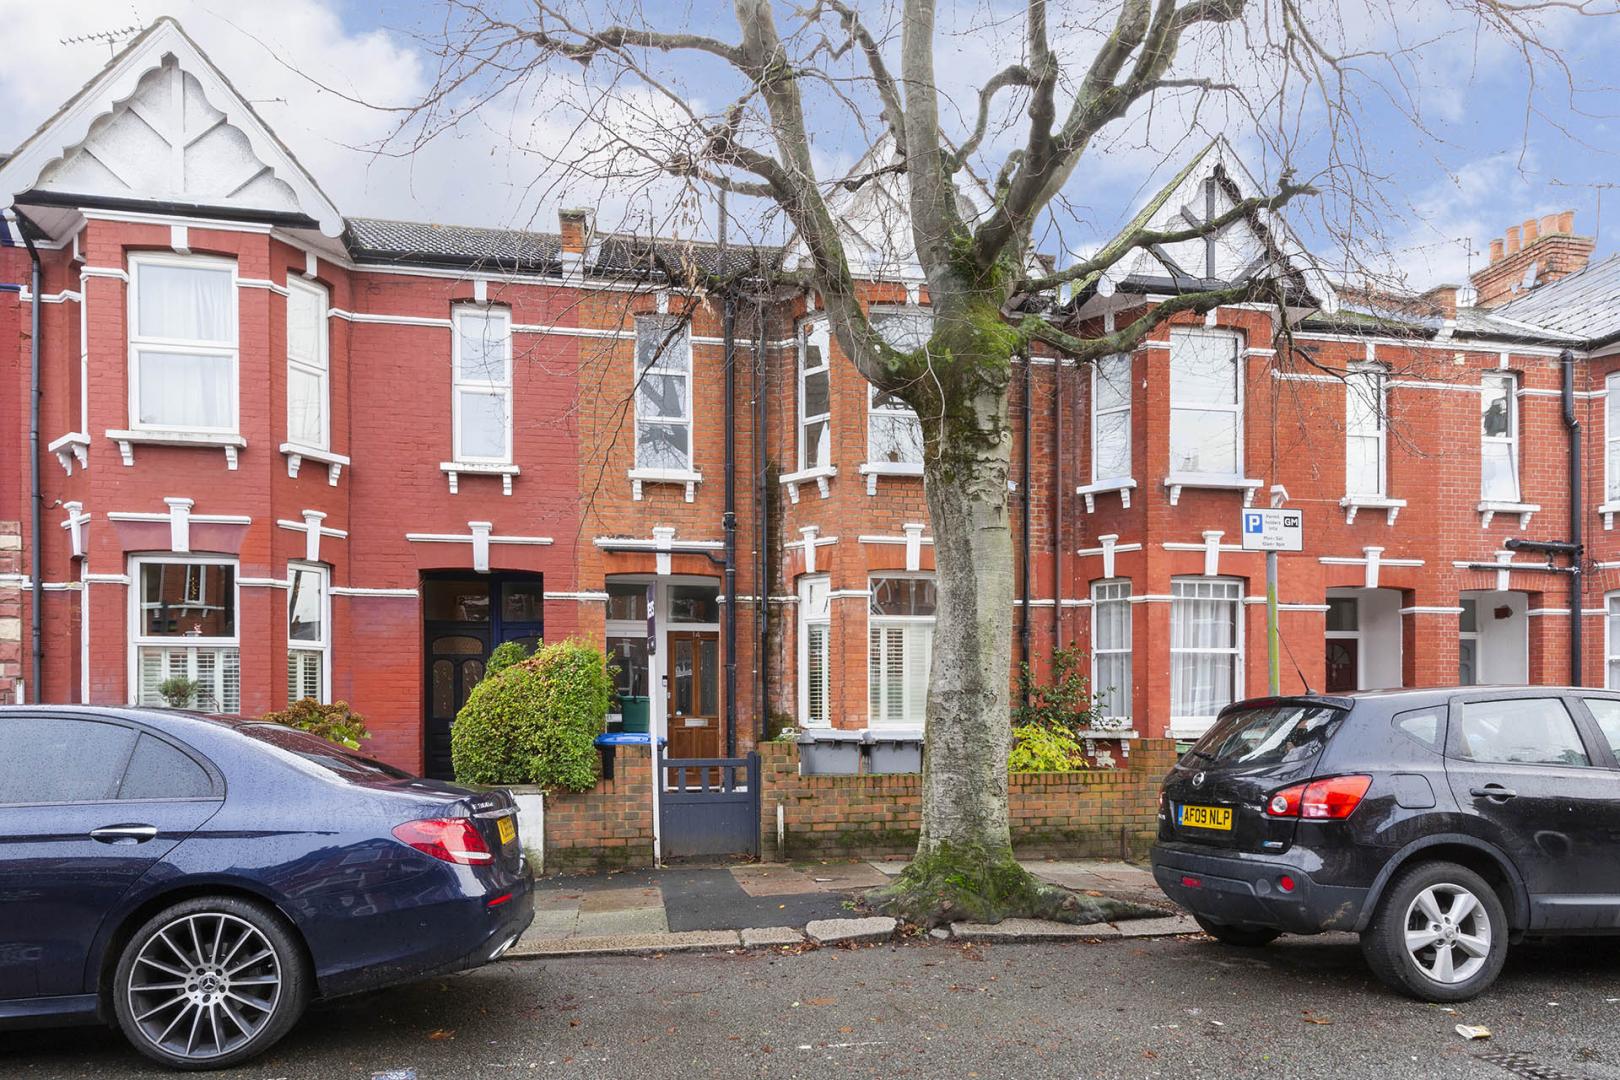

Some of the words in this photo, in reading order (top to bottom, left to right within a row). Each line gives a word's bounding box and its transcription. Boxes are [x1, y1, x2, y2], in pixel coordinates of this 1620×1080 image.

[1249, 516, 1260, 532] P
[1284, 518, 1298, 526] GM
[1184, 807, 1207, 823] AF09
[1210, 809, 1230, 825] NLP
